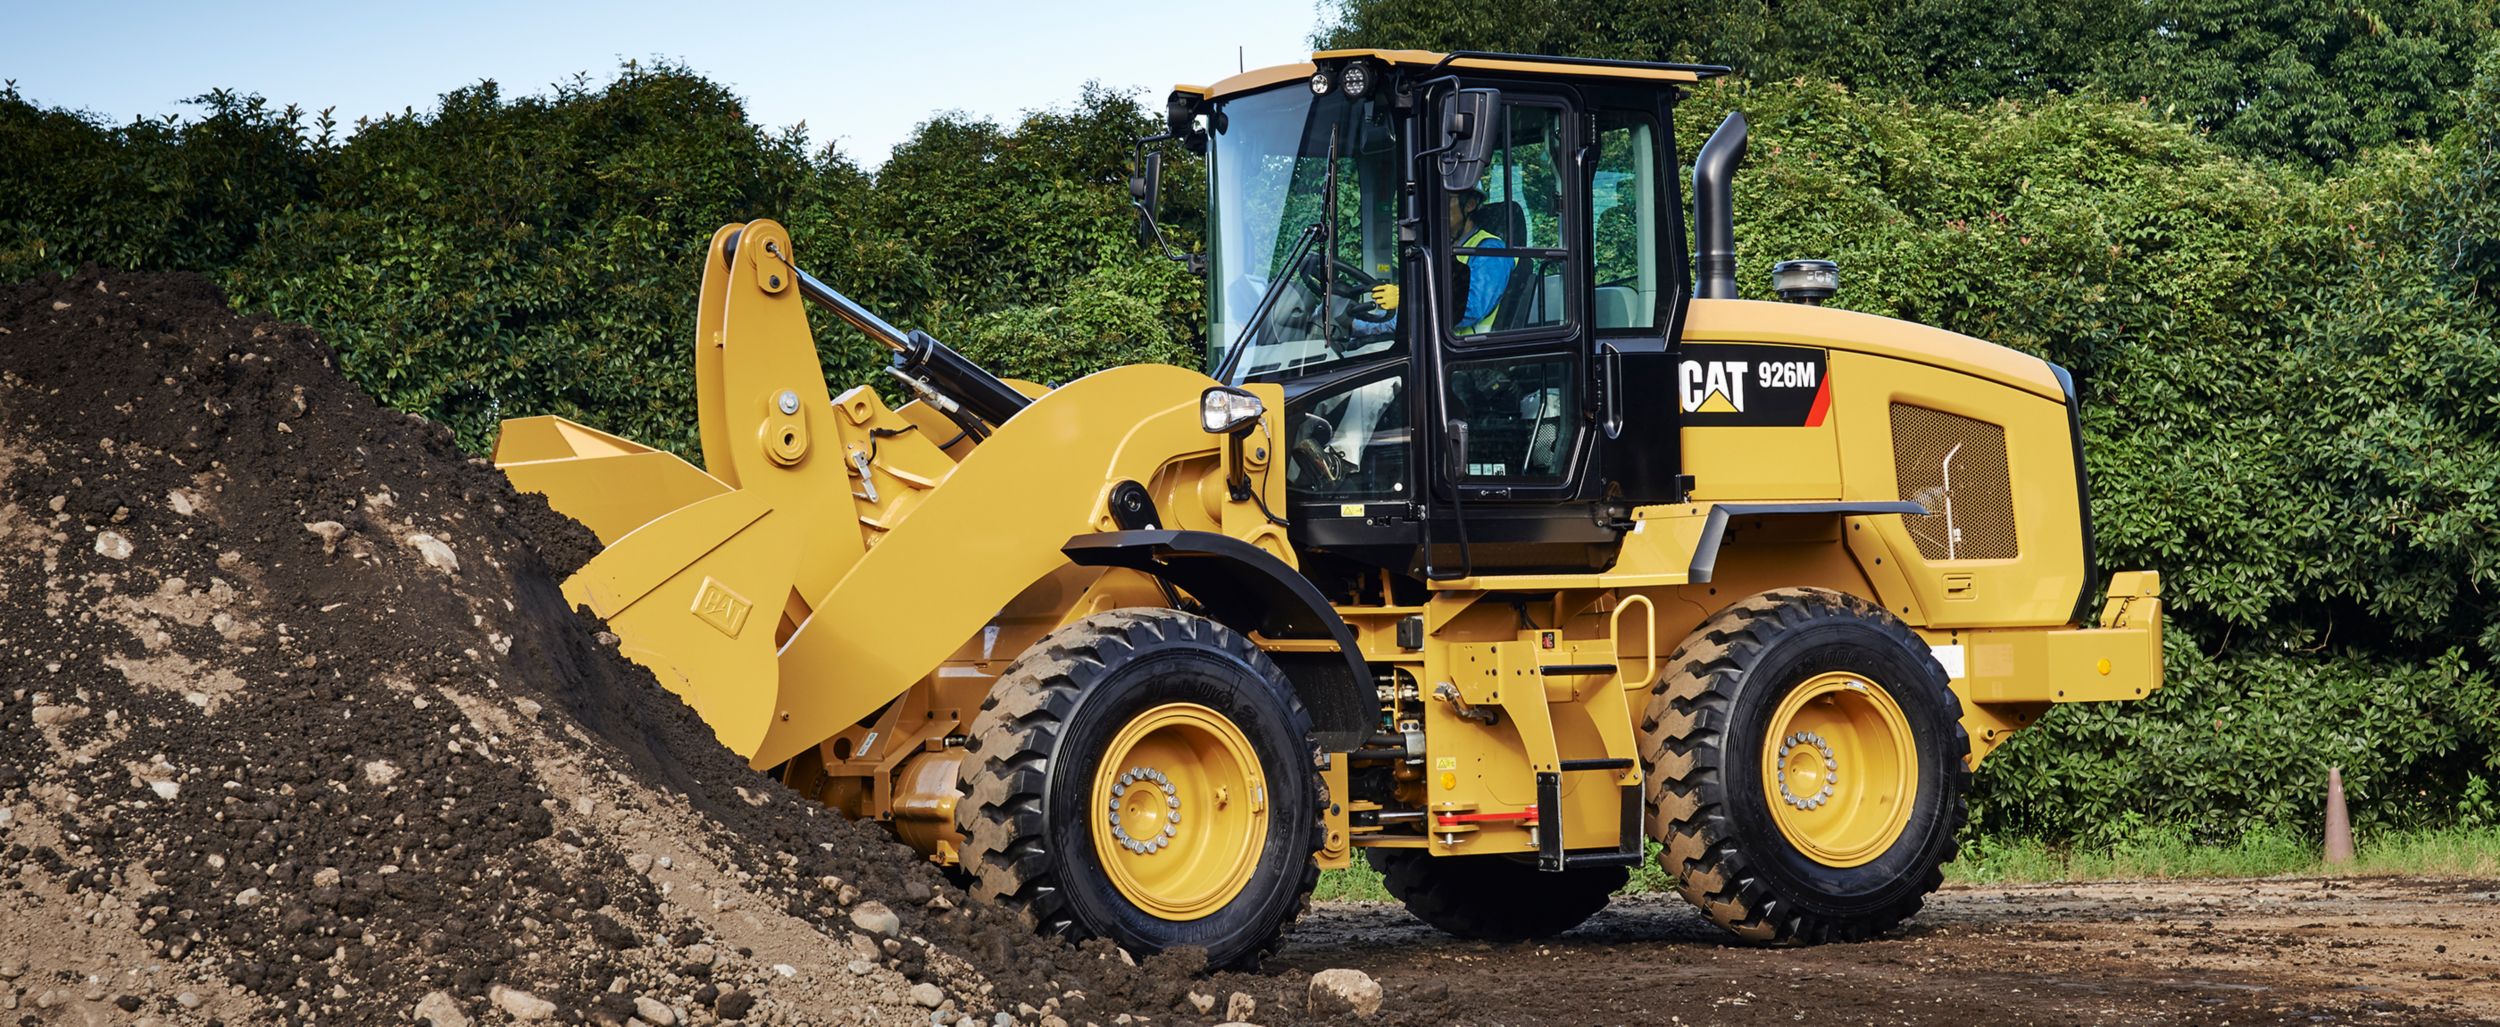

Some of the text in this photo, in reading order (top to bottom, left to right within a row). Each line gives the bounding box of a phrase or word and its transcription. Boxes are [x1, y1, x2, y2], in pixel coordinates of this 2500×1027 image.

[1680, 360, 1816, 413] CAT 926M
[701, 586, 747, 629] CAT
